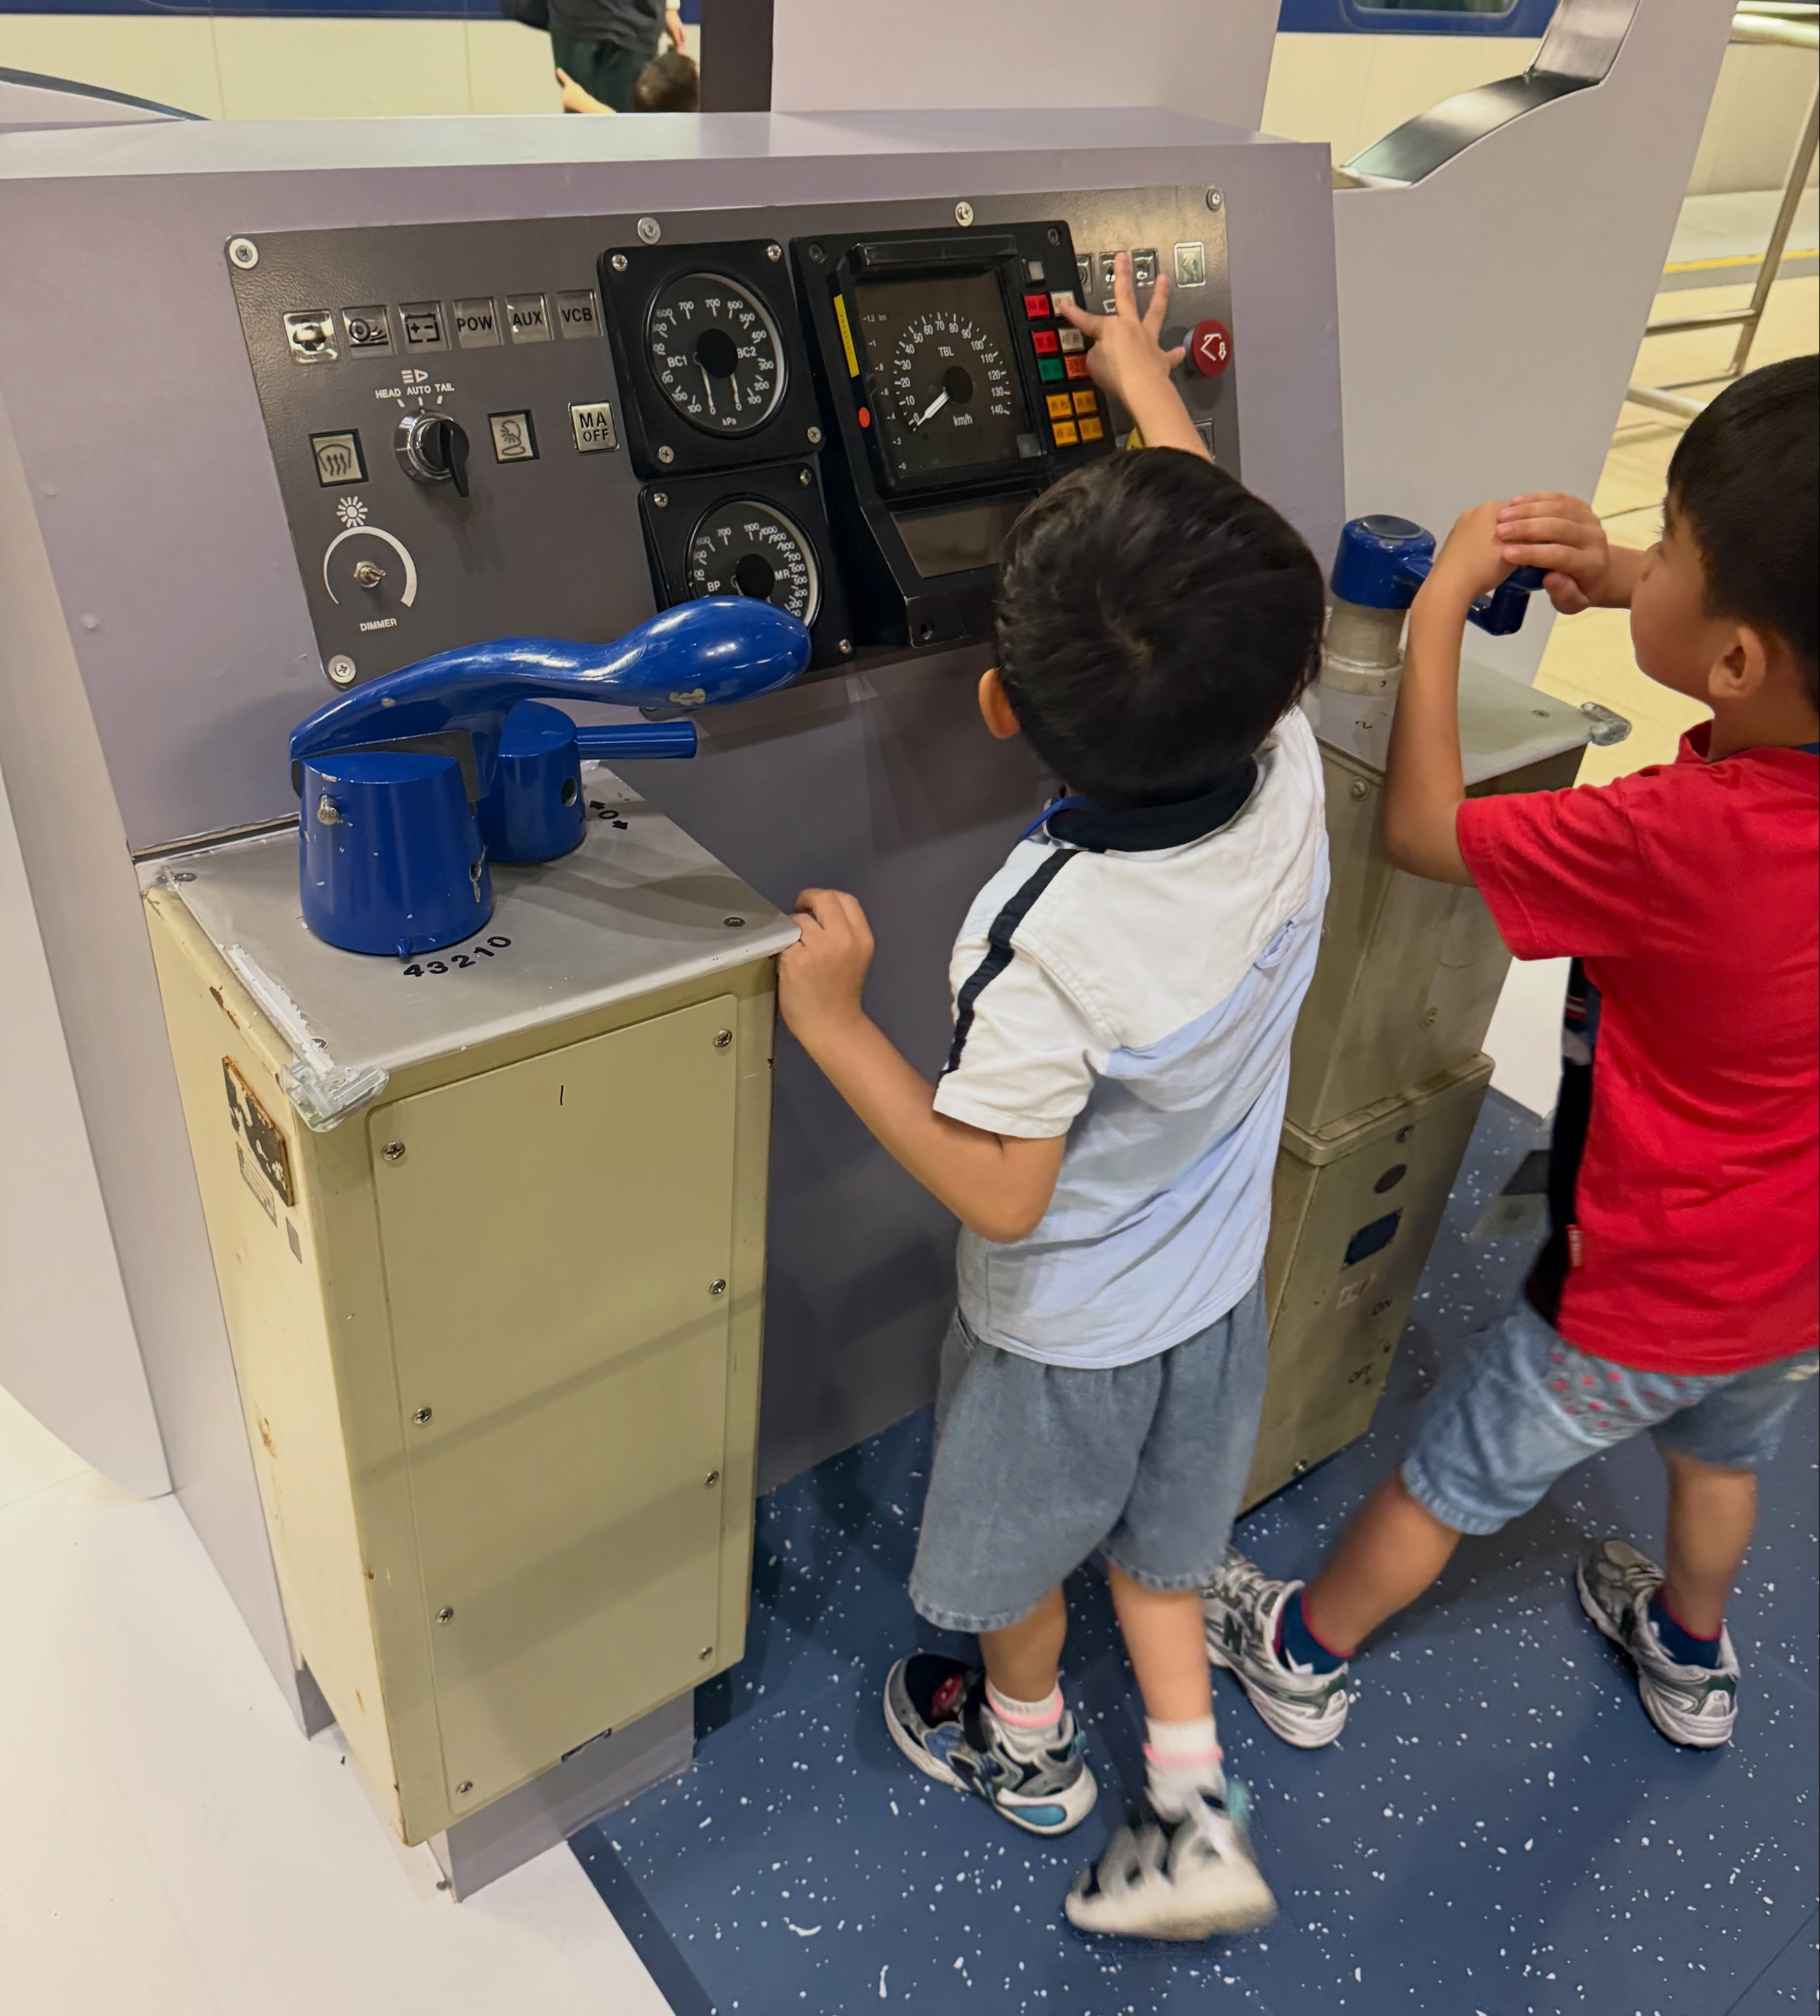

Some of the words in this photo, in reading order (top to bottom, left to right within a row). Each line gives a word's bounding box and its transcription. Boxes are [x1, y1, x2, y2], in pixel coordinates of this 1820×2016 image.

[679, 301, 694, 311] 700
[705, 298, 721, 309] 700
[727, 300, 743, 310] 600
[513, 311, 543, 326] AUX
[562, 307, 593, 323] VCB
[739, 313, 755, 323] 500
[457, 315, 493, 332] POW
[935, 320, 945, 331] 70
[949, 322, 959, 333] 80
[924, 324, 933, 335] 60
[961, 329, 972, 339] 90
[751, 330, 766, 340] 400
[913, 332, 923, 343] 50
[906, 344, 915, 354] 40
[971, 340, 984, 351] 100
[737, 346, 757, 359] BC2
[938, 346, 954, 357] TBL
[667, 355, 688, 368] BC1
[981, 353, 994, 364] 110
[758, 361, 774, 371] 300
[901, 360, 911, 370] 30
[988, 370, 1001, 380] 120
[753, 381, 769, 391] 200
[901, 377, 910, 388] 20
[375, 389, 401, 400] HEAD
[407, 385, 432, 396] AUTO
[434, 382, 455, 393] TAIL
[991, 386, 1004, 397] 130
[747, 395, 761, 405] 100
[905, 395, 915, 406] 10
[688, 404, 702, 413] 100
[710, 407, 717, 415] 0
[736, 403, 742, 411] 0
[991, 404, 1004, 415] 140
[579, 411, 607, 429] MA
[722, 417, 737, 426] kPa
[913, 412, 919, 422] 0
[953, 413, 973, 427] km/h
[583, 429, 609, 443] OFF
[717, 527, 731, 537] 700
[744, 522, 759, 532] 1100
[772, 533, 786, 542] 900
[781, 541, 795, 551] 800
[788, 553, 801, 562] 700
[791, 564, 806, 573] 600
[774, 569, 790, 581] MR
[794, 575, 807, 585] 500
[707, 580, 721, 592] BP
[794, 589, 808, 598] 400
[789, 600, 803, 609] 300
[359, 617, 398, 632] DIMMER
[598, 810, 619, 819] 0
